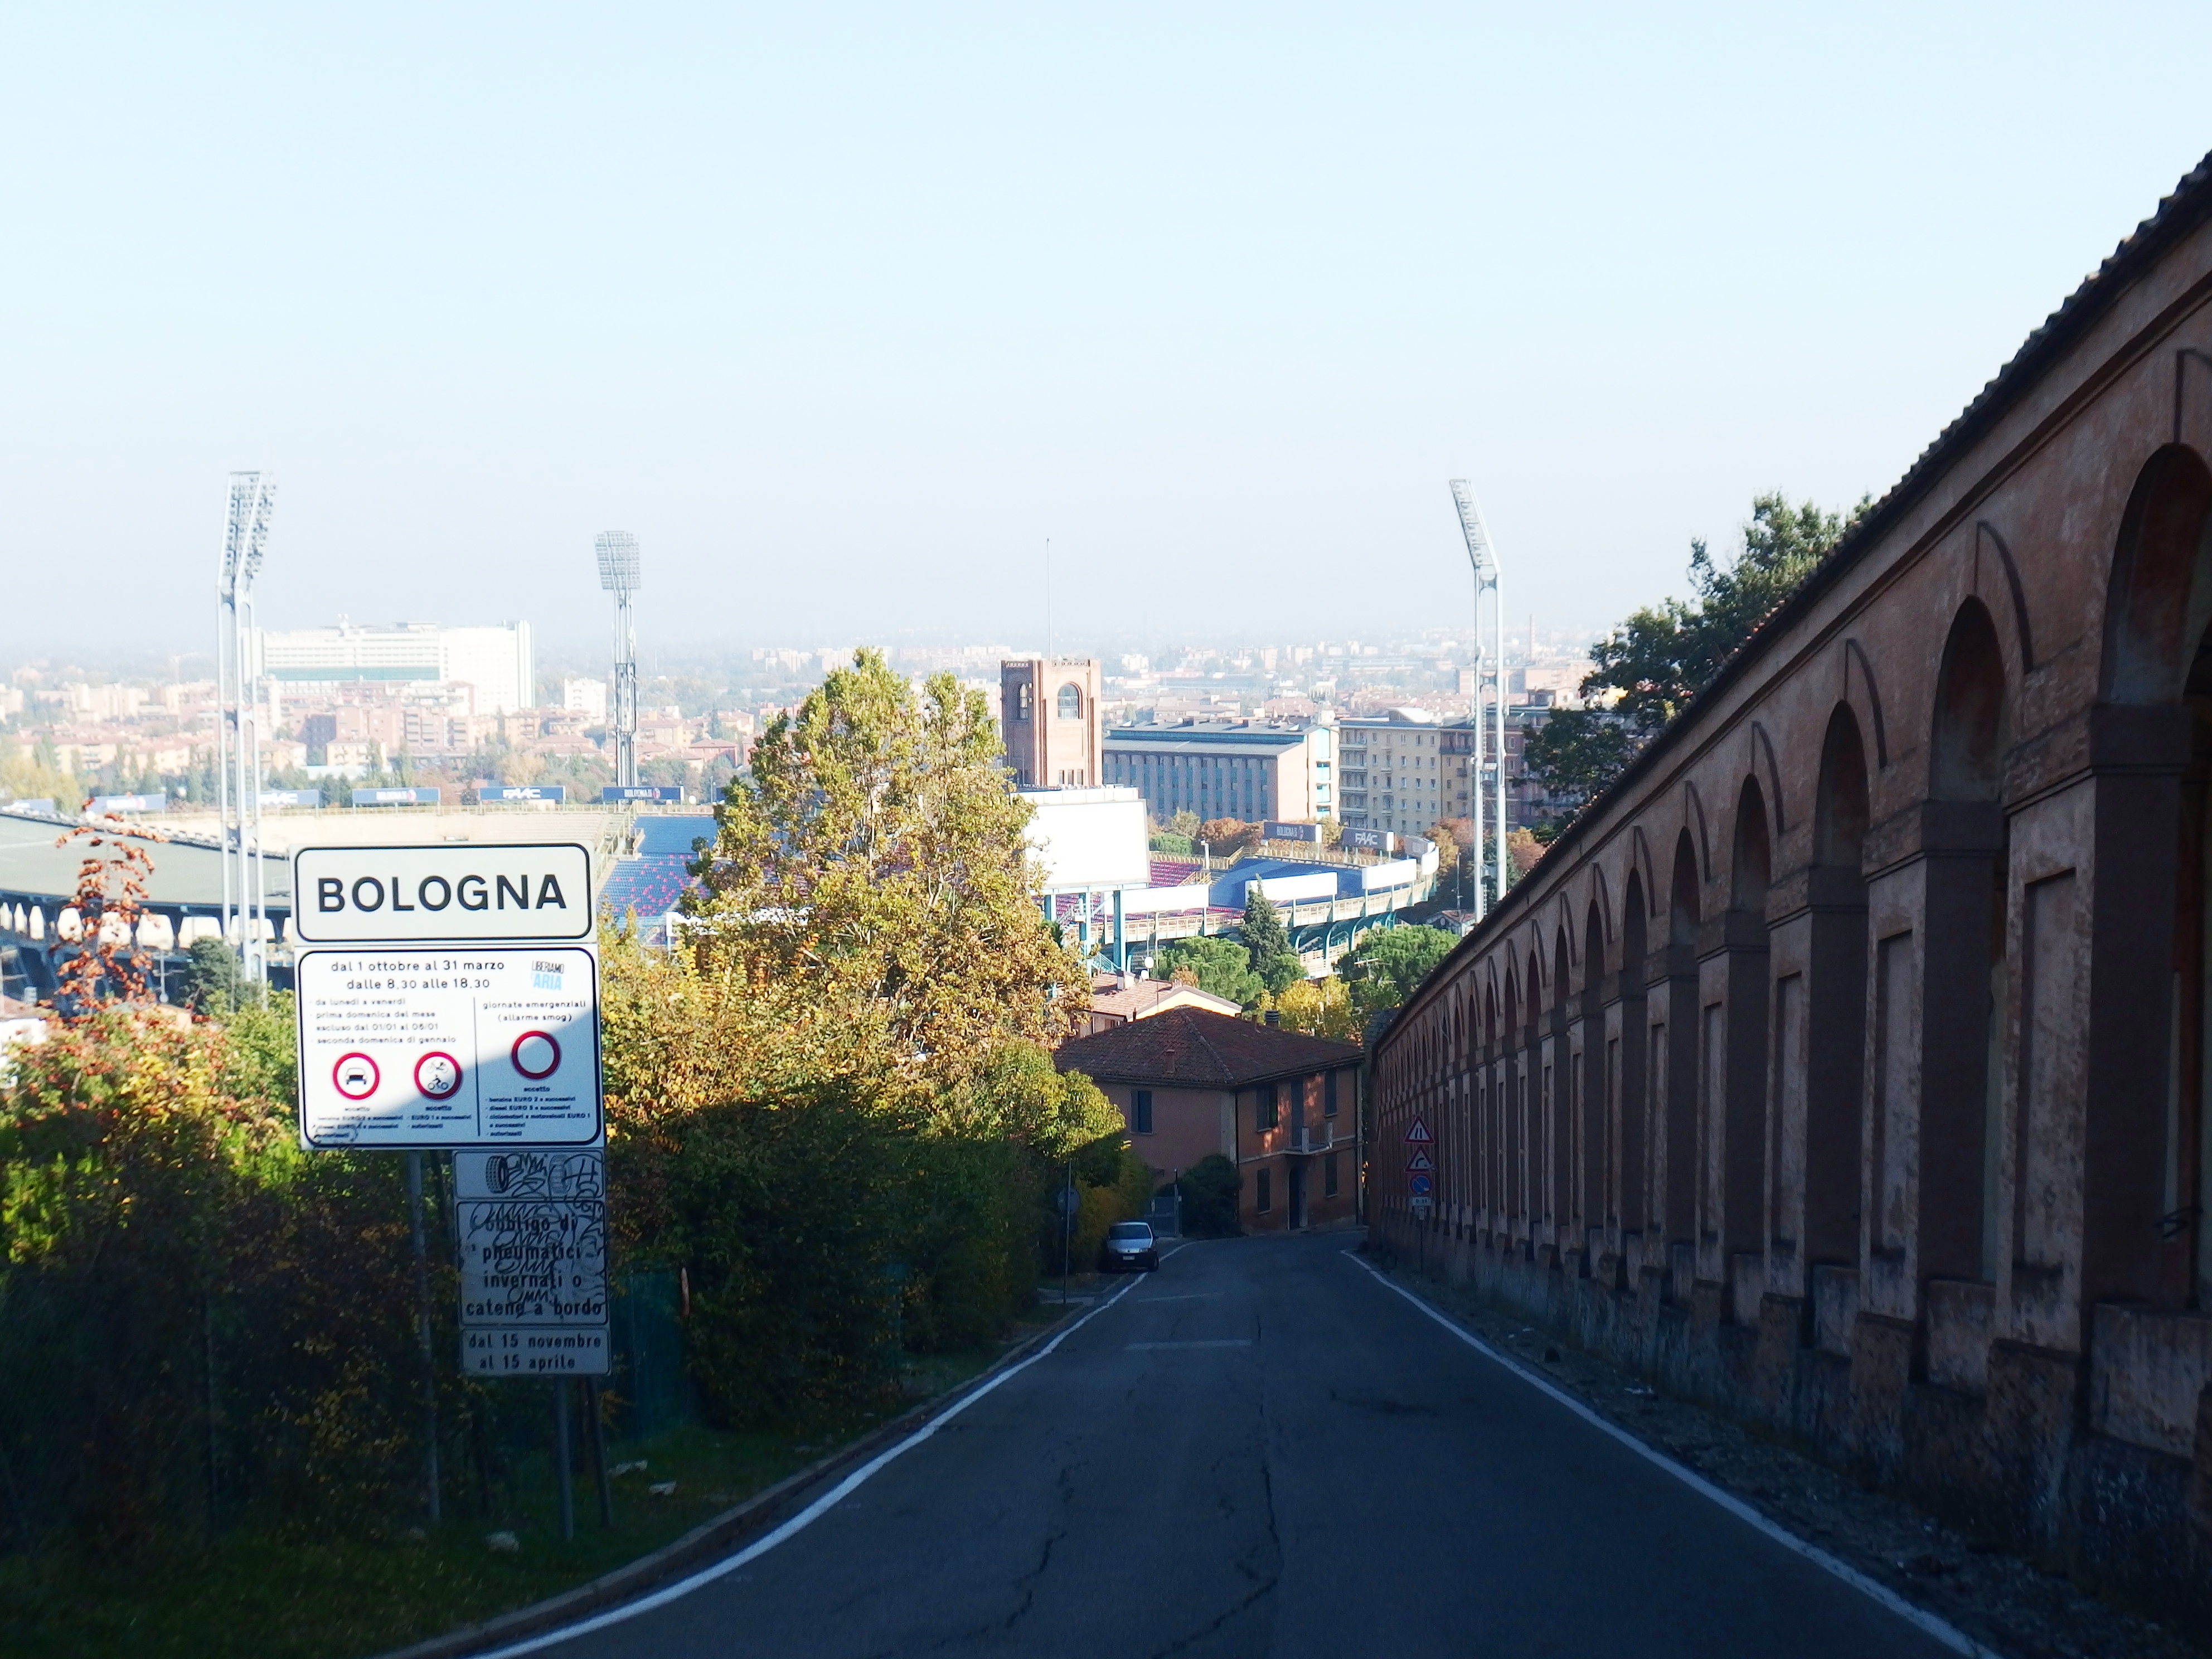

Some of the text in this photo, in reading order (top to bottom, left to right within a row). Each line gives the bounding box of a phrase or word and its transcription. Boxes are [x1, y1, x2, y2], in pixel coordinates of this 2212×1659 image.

[503, 787, 541, 798] FAAC
[1355, 832, 1377, 845] FAAC
[318, 874, 567, 913] BOLOGNA
[331, 961, 504, 971] dal 1 ottobre al 31 marzo
[532, 961, 564, 974] LIBERIAMO
[347, 978, 489, 989] dalle 8.30 alle 18.30
[542, 1013, 572, 1022] smog)
[485, 1214, 551, 1235] obbligo
[560, 1213, 576, 1231] di
[483, 1243, 581, 1263] pneumatici
[573, 1275, 581, 1287] o
[466, 1296, 601, 1316] catene a bordo
[468, 1333, 601, 1348] dal 15 novembre
[480, 1355, 575, 1372] al 15 aprile
